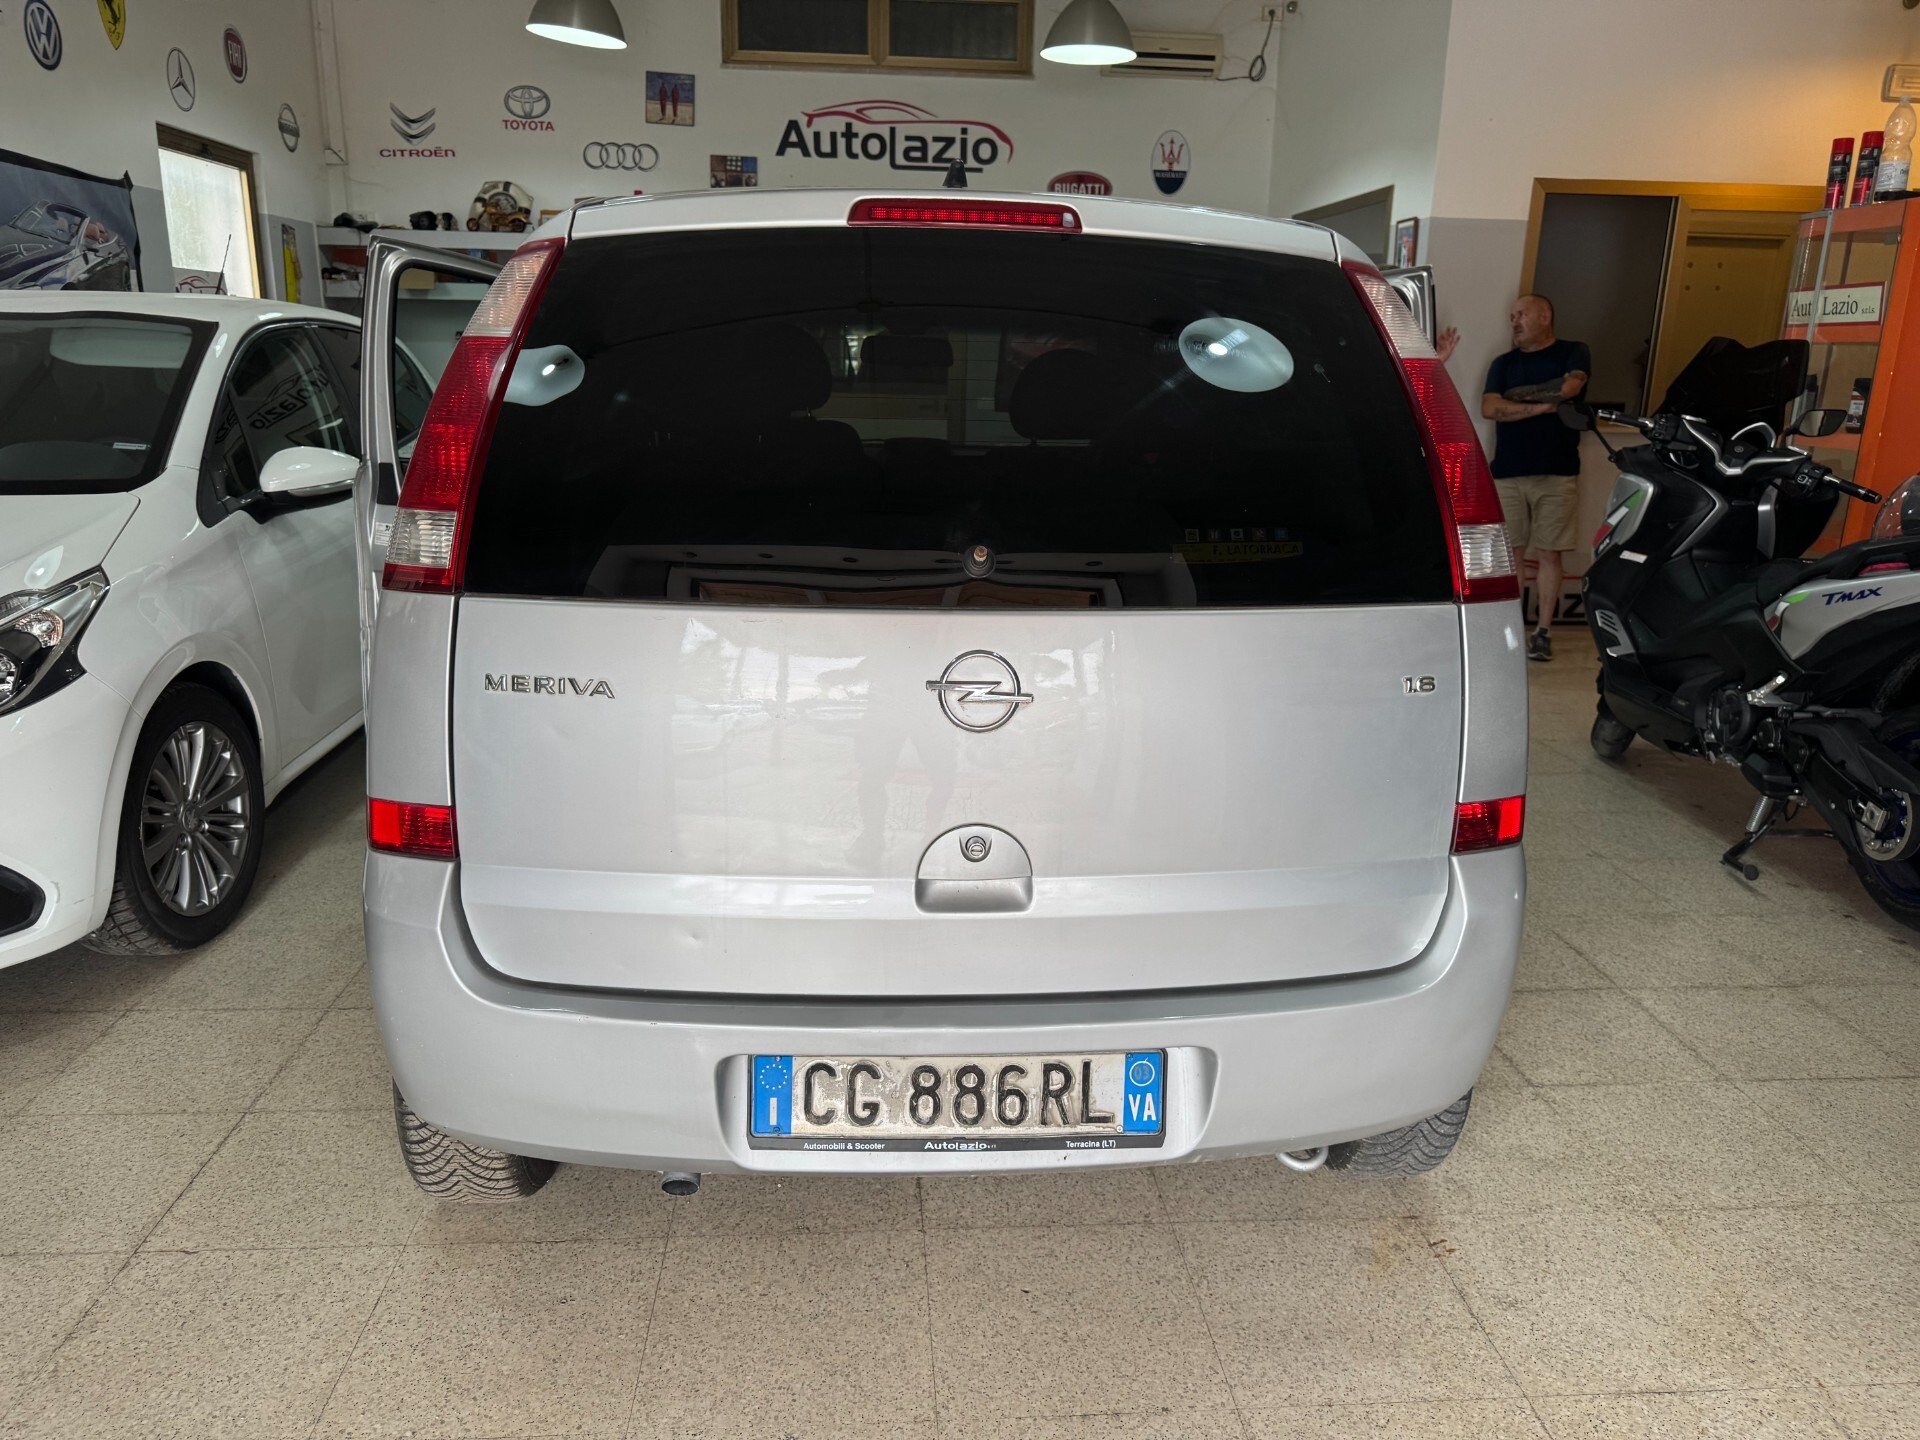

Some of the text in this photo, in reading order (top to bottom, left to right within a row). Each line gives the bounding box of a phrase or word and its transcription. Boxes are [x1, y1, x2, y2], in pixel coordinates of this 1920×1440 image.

[227, 40, 242, 68] FIAT
[502, 119, 555, 132] TOYOTA
[1054, 183, 1105, 195] BUGATTI
[1791, 298, 1817, 317] Aut
[1823, 294, 1858, 316] Lazio
[1821, 586, 1883, 606] TMAX
[484, 673, 616, 699] MERIVA
[1128, 1093, 1157, 1122] VA
[803, 1142, 885, 1151] Automobili & Scooter
[1066, 1139, 1117, 1150] Terracina (LT)
